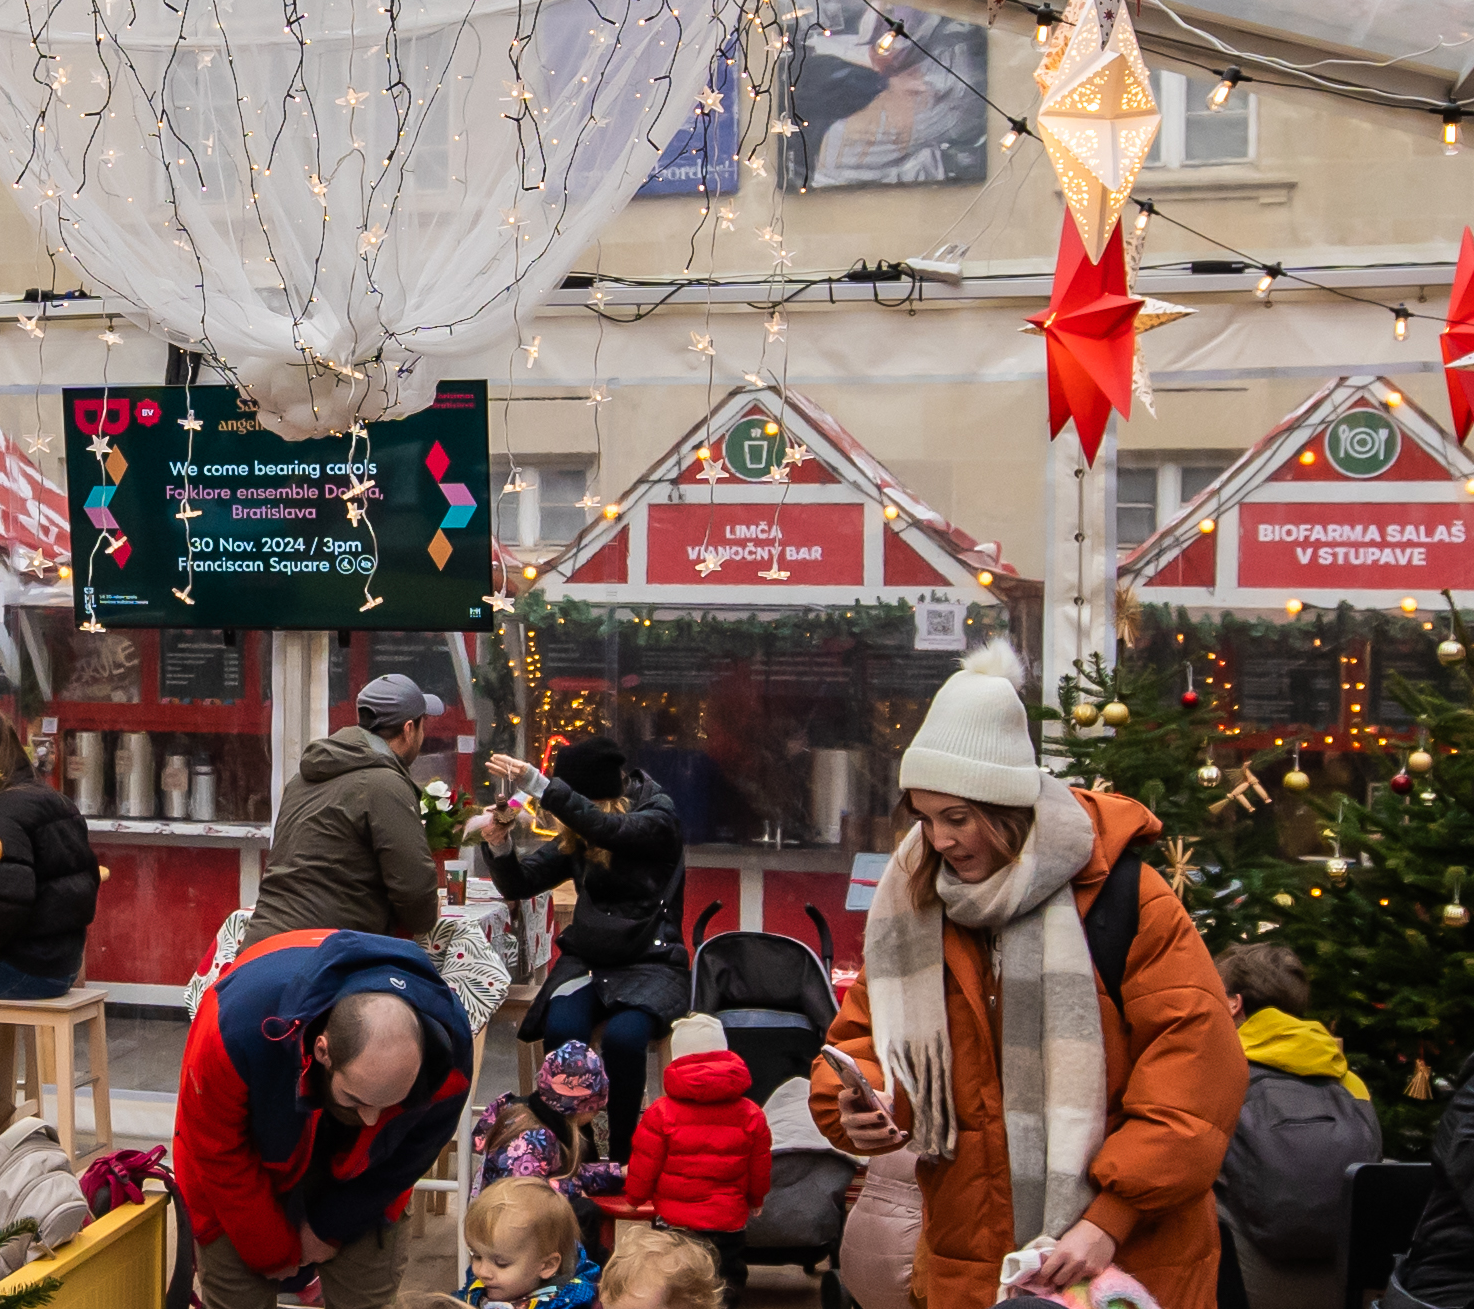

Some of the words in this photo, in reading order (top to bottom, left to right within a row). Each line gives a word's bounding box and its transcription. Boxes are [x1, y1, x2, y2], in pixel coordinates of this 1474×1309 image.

[169, 461, 198, 476] We
[203, 464, 249, 476] come
[254, 460, 321, 479] bearing
[326, 461, 377, 476] carols
[166, 485, 231, 499] Folklore
[236, 484, 319, 499] ensemble
[232, 505, 317, 519] Bratislava
[725, 521, 784, 540] LIMČA
[1258, 524, 1381, 542] BIOFARMA
[1386, 520, 1466, 542] SALAŠ
[190, 537, 214, 552] 30
[219, 538, 257, 552] Nov.
[261, 537, 306, 552] 2024
[310, 536, 318, 555] /
[323, 537, 362, 555] 3pm
[785, 545, 823, 562] BAR
[178, 557, 264, 572] Franciscan
[269, 557, 330, 575] Square
[1296, 548, 1313, 566] V
[1317, 547, 1427, 565] STUPAVE
